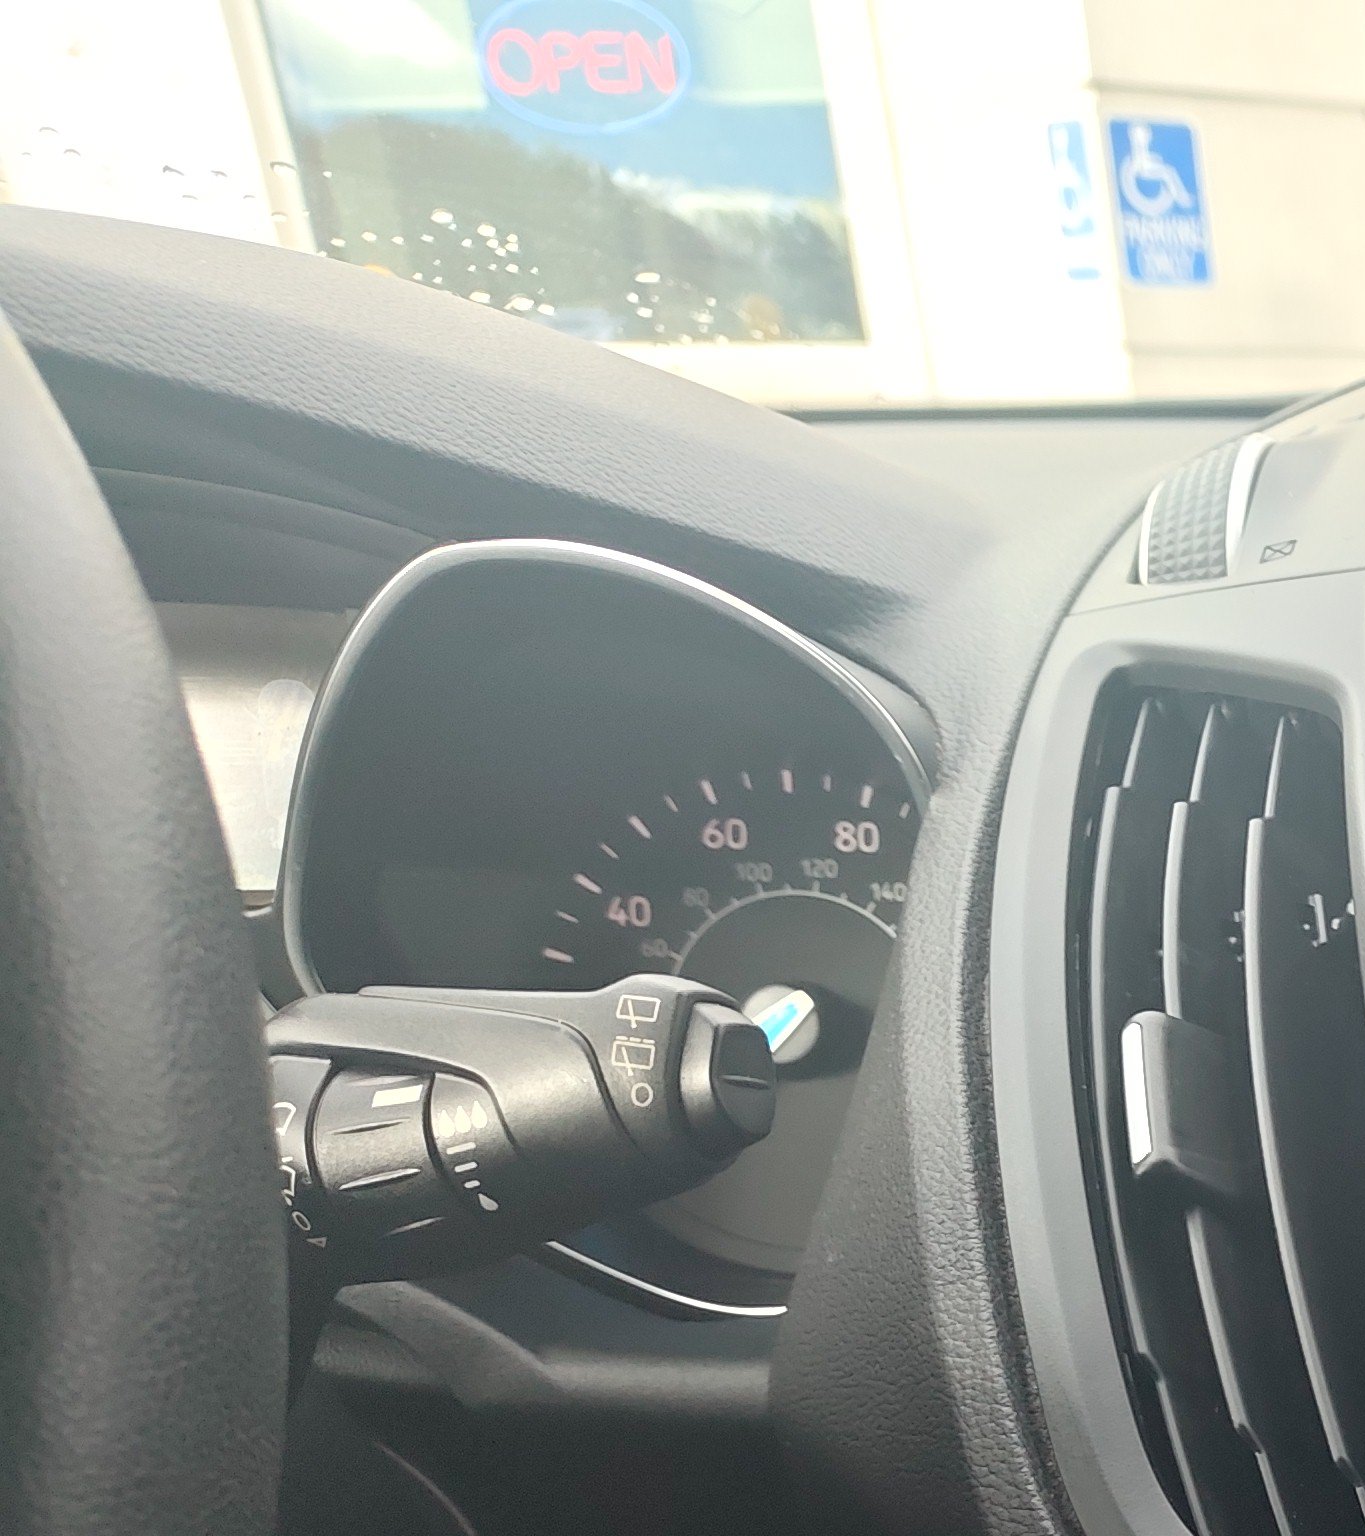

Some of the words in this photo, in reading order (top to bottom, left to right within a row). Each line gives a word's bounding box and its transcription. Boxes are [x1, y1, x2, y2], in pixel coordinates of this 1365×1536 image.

[486, 27, 677, 97] OPEN
[701, 818, 749, 850] 60
[833, 820, 880, 854] 80
[800, 858, 839, 880] 120
[606, 895, 652, 928] 40
